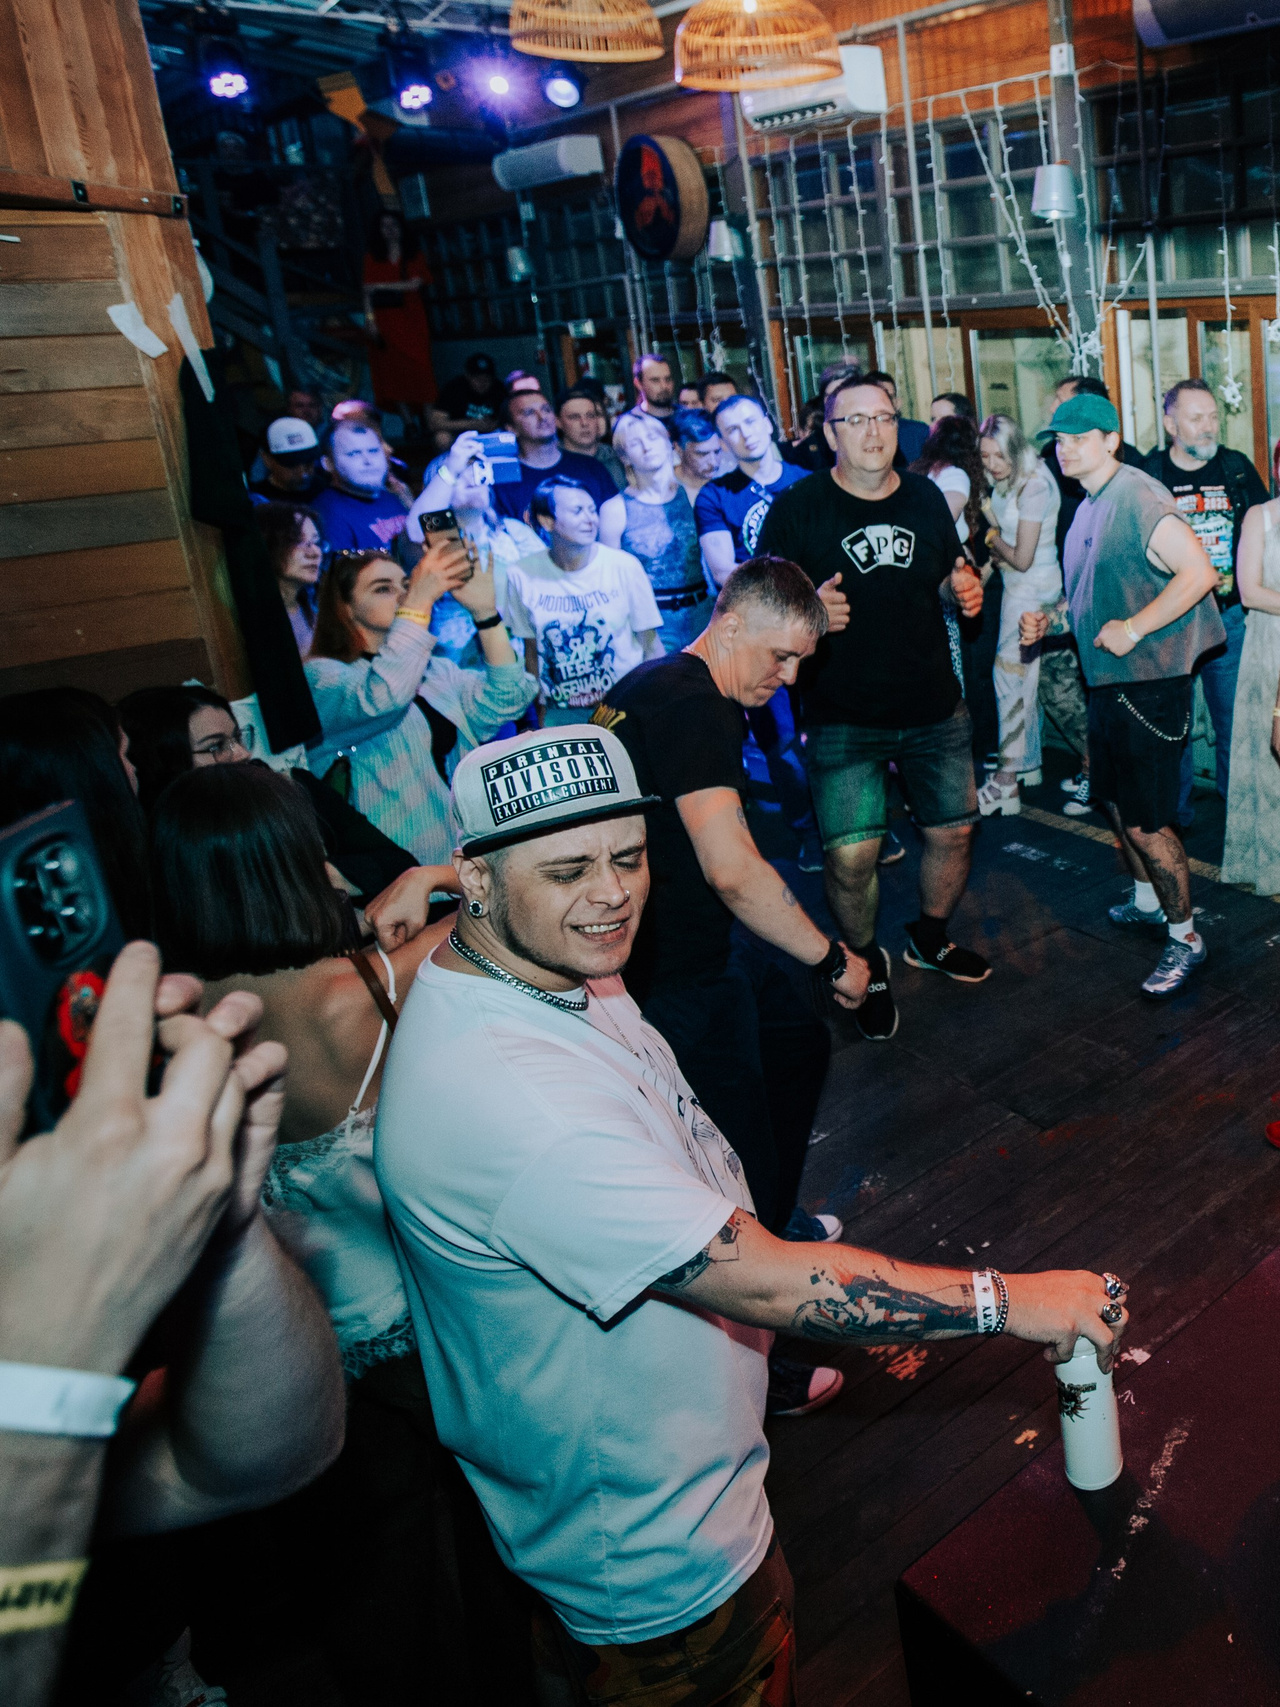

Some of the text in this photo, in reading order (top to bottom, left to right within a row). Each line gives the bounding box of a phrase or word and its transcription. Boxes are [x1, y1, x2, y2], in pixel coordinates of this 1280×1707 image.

[852, 537, 909, 563] FPG
[556, 656, 594, 680] ТЕБЕ
[488, 742, 599, 780] PARENTAL
[489, 754, 612, 805] ADVISORY
[496, 778, 613, 820] EXPLICIT CONTENT
